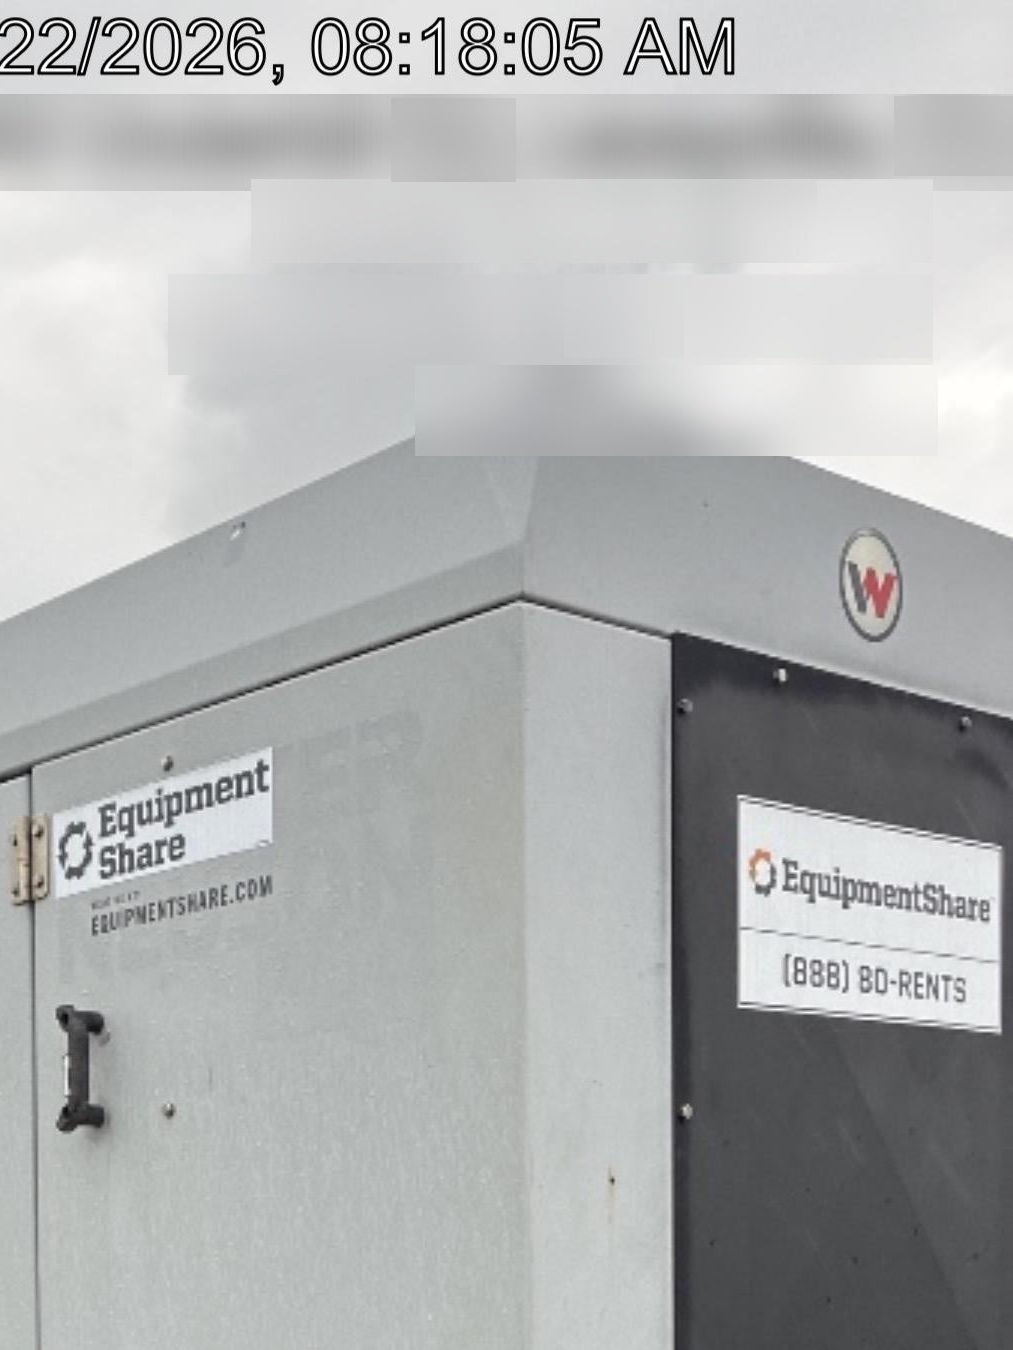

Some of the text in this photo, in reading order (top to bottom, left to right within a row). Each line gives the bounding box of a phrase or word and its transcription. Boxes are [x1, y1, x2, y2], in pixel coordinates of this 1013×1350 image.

[98, 758, 270, 838] Equipment
[98, 833, 186, 880] Share
[91, 875, 274, 937] EQUIPMENTSHARE.COM
[781, 857, 991, 922] EquipmentShare
[783, 953, 850, 994] (888)
